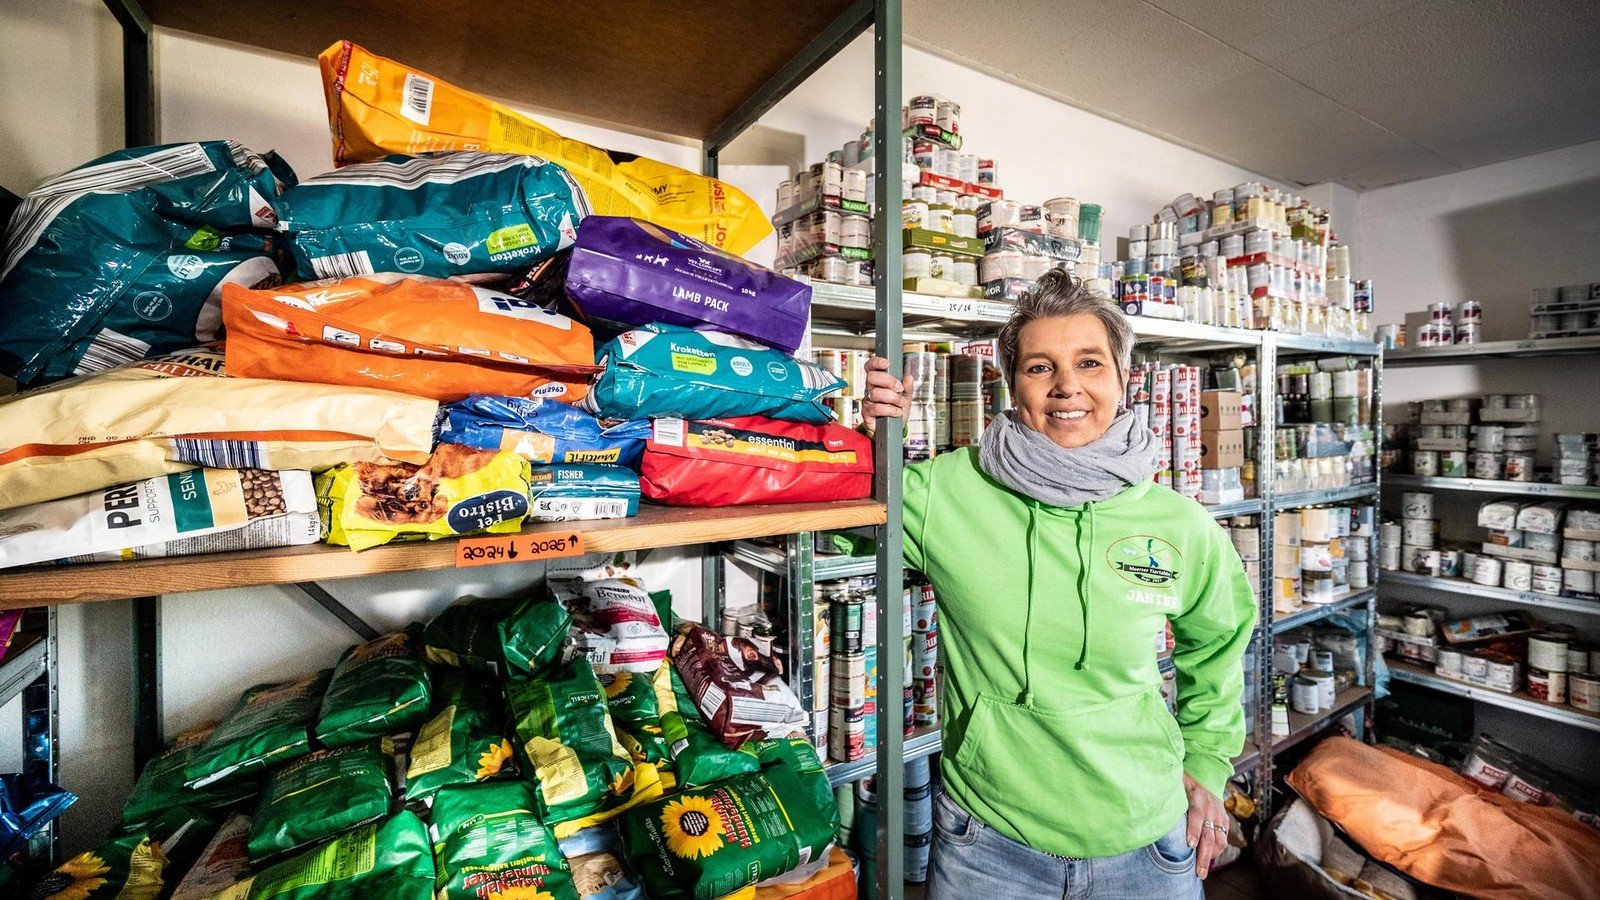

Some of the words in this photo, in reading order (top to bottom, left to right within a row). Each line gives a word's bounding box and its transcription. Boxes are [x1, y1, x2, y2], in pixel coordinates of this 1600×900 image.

[447, 252, 469, 261] ADULT
[489, 245, 541, 262] Kroketten
[672, 286, 701, 304] LAMB
[704, 296, 730, 312] PACK
[670, 341, 716, 358] Kroketten
[143, 362, 179, 374] MIT
[732, 360, 751, 369] ADULT
[748, 436, 796, 451] essential
[557, 470, 584, 479] FISHER
[103, 480, 142, 530] PER
[144, 479, 160, 523] SUPPORTS
[458, 495, 516, 519] Bistro
[307, 520, 318, 528] kg
[476, 513, 504, 530] Pet
[463, 546, 504, 561] 2024
[530, 538, 566, 555] 2025
[596, 589, 646, 604] Beneful
[1126, 589, 1178, 609] JANINE
[570, 693, 599, 703] ACTICELL
[756, 740, 777, 753] CTICELL
